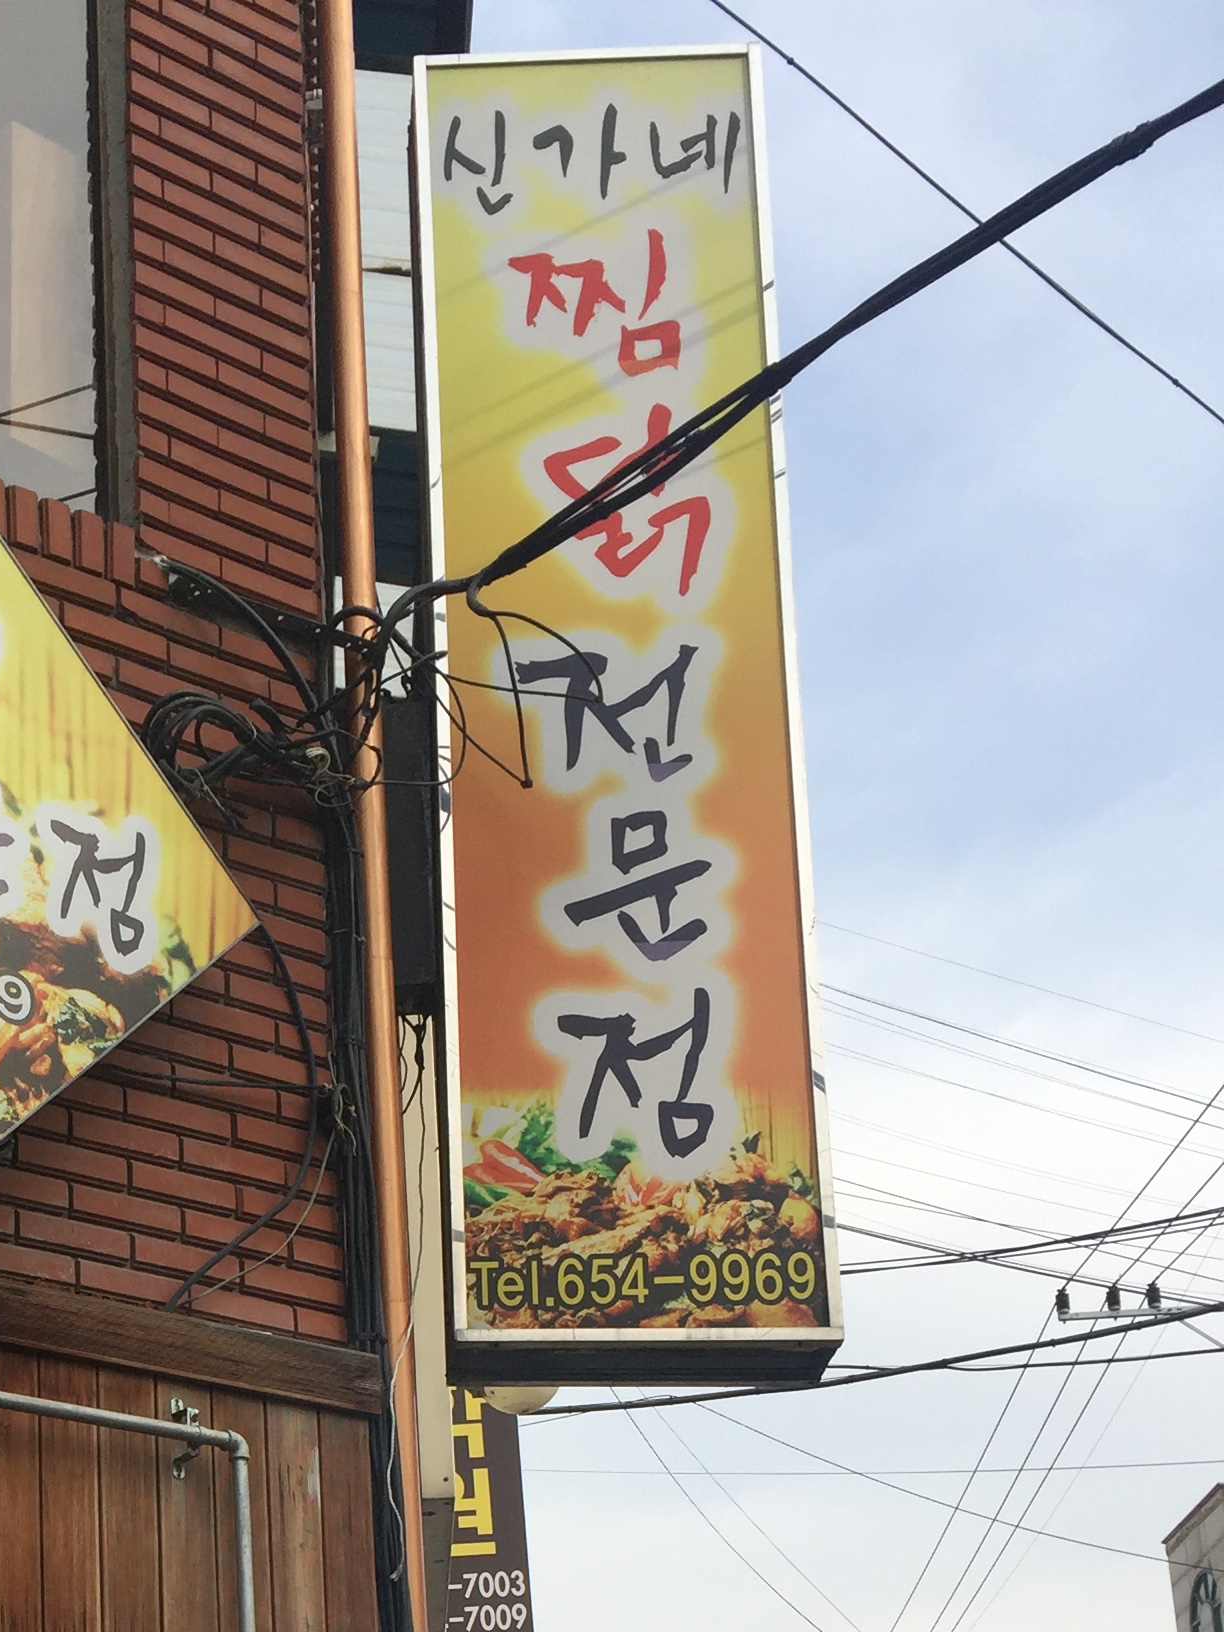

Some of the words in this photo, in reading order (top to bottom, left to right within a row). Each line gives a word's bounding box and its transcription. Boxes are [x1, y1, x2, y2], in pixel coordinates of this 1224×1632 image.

[443, 103, 741, 215] 신가네
[508, 228, 712, 597] 찜닭
[514, 643, 714, 1159] 전문점
[470, 1251, 817, 1307] Tel.654-9969
[445, 1603, 528, 1632] -7009
